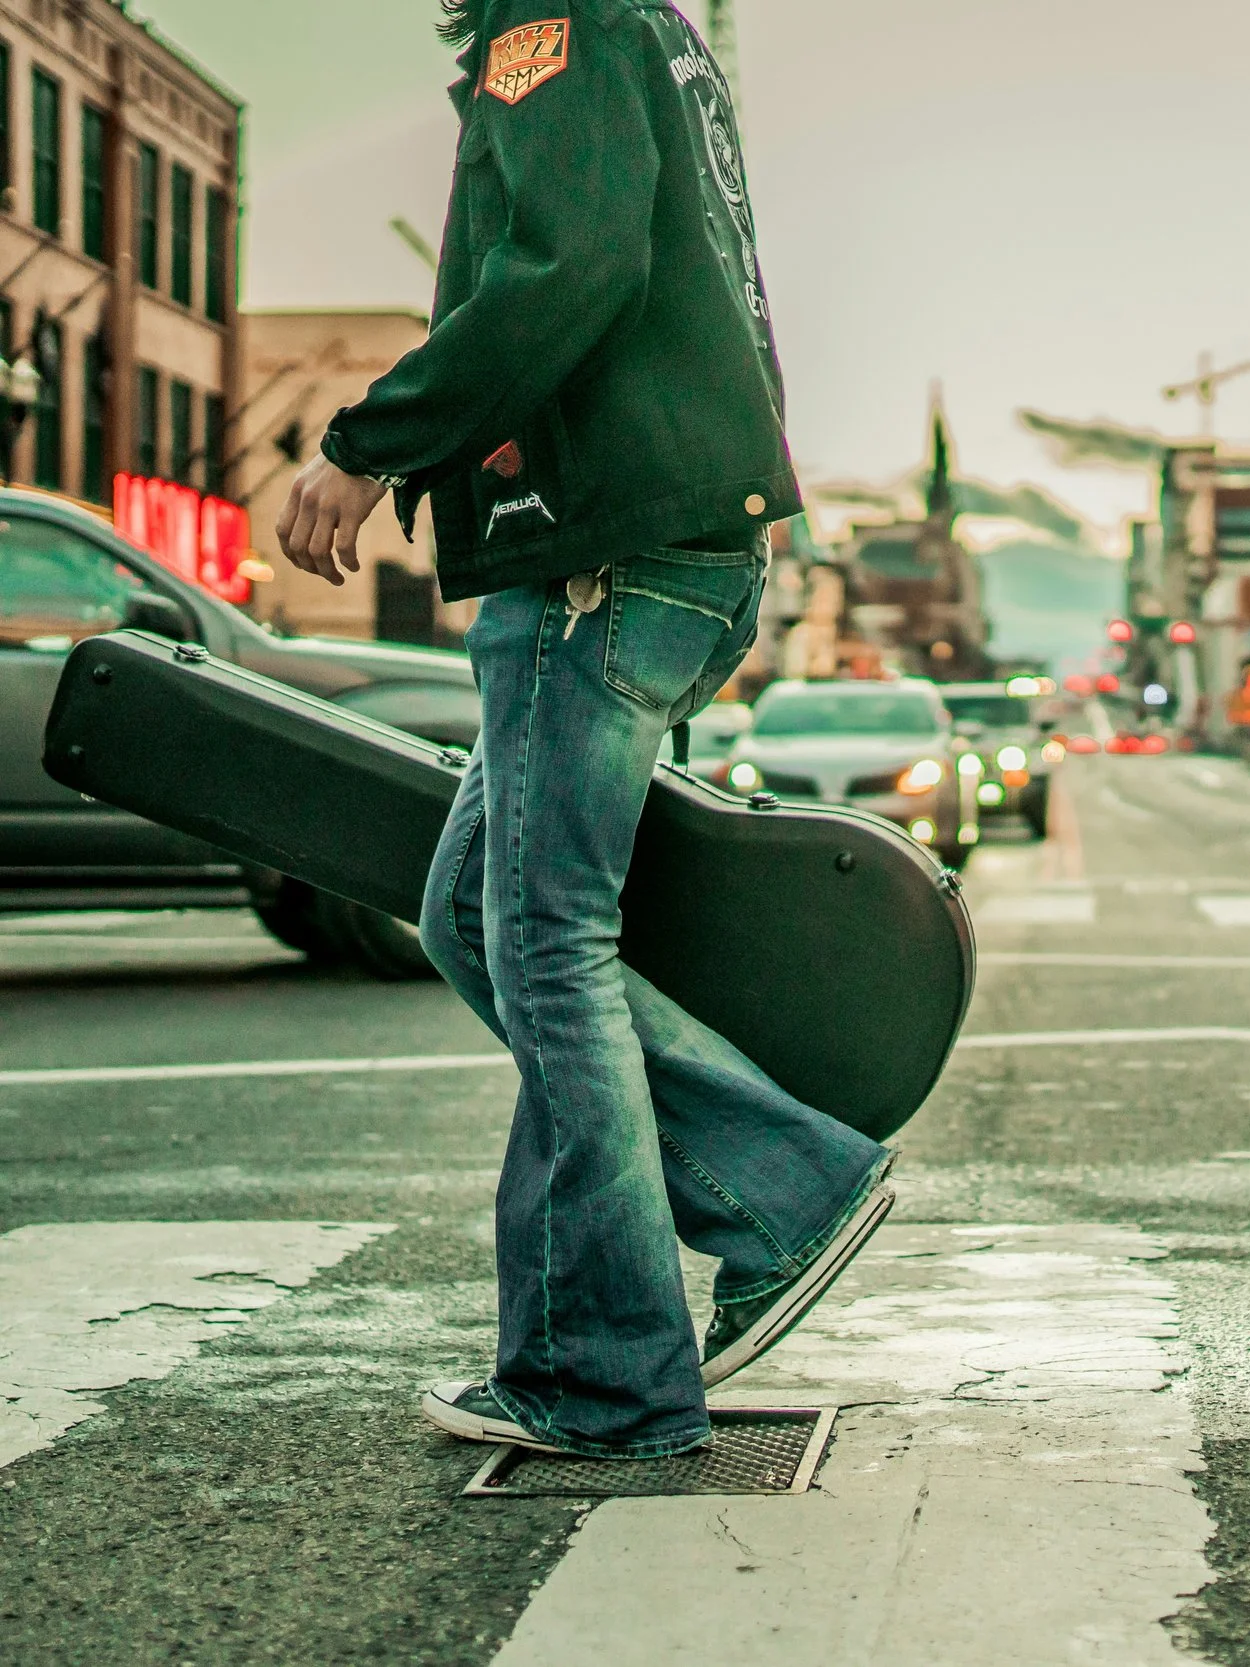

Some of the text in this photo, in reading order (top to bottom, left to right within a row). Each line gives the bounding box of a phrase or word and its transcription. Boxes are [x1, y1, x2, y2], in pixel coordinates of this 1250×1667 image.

[490, 25, 562, 75] KISS
[495, 65, 548, 100] ARMY
[485, 491, 556, 540] METALLICA
